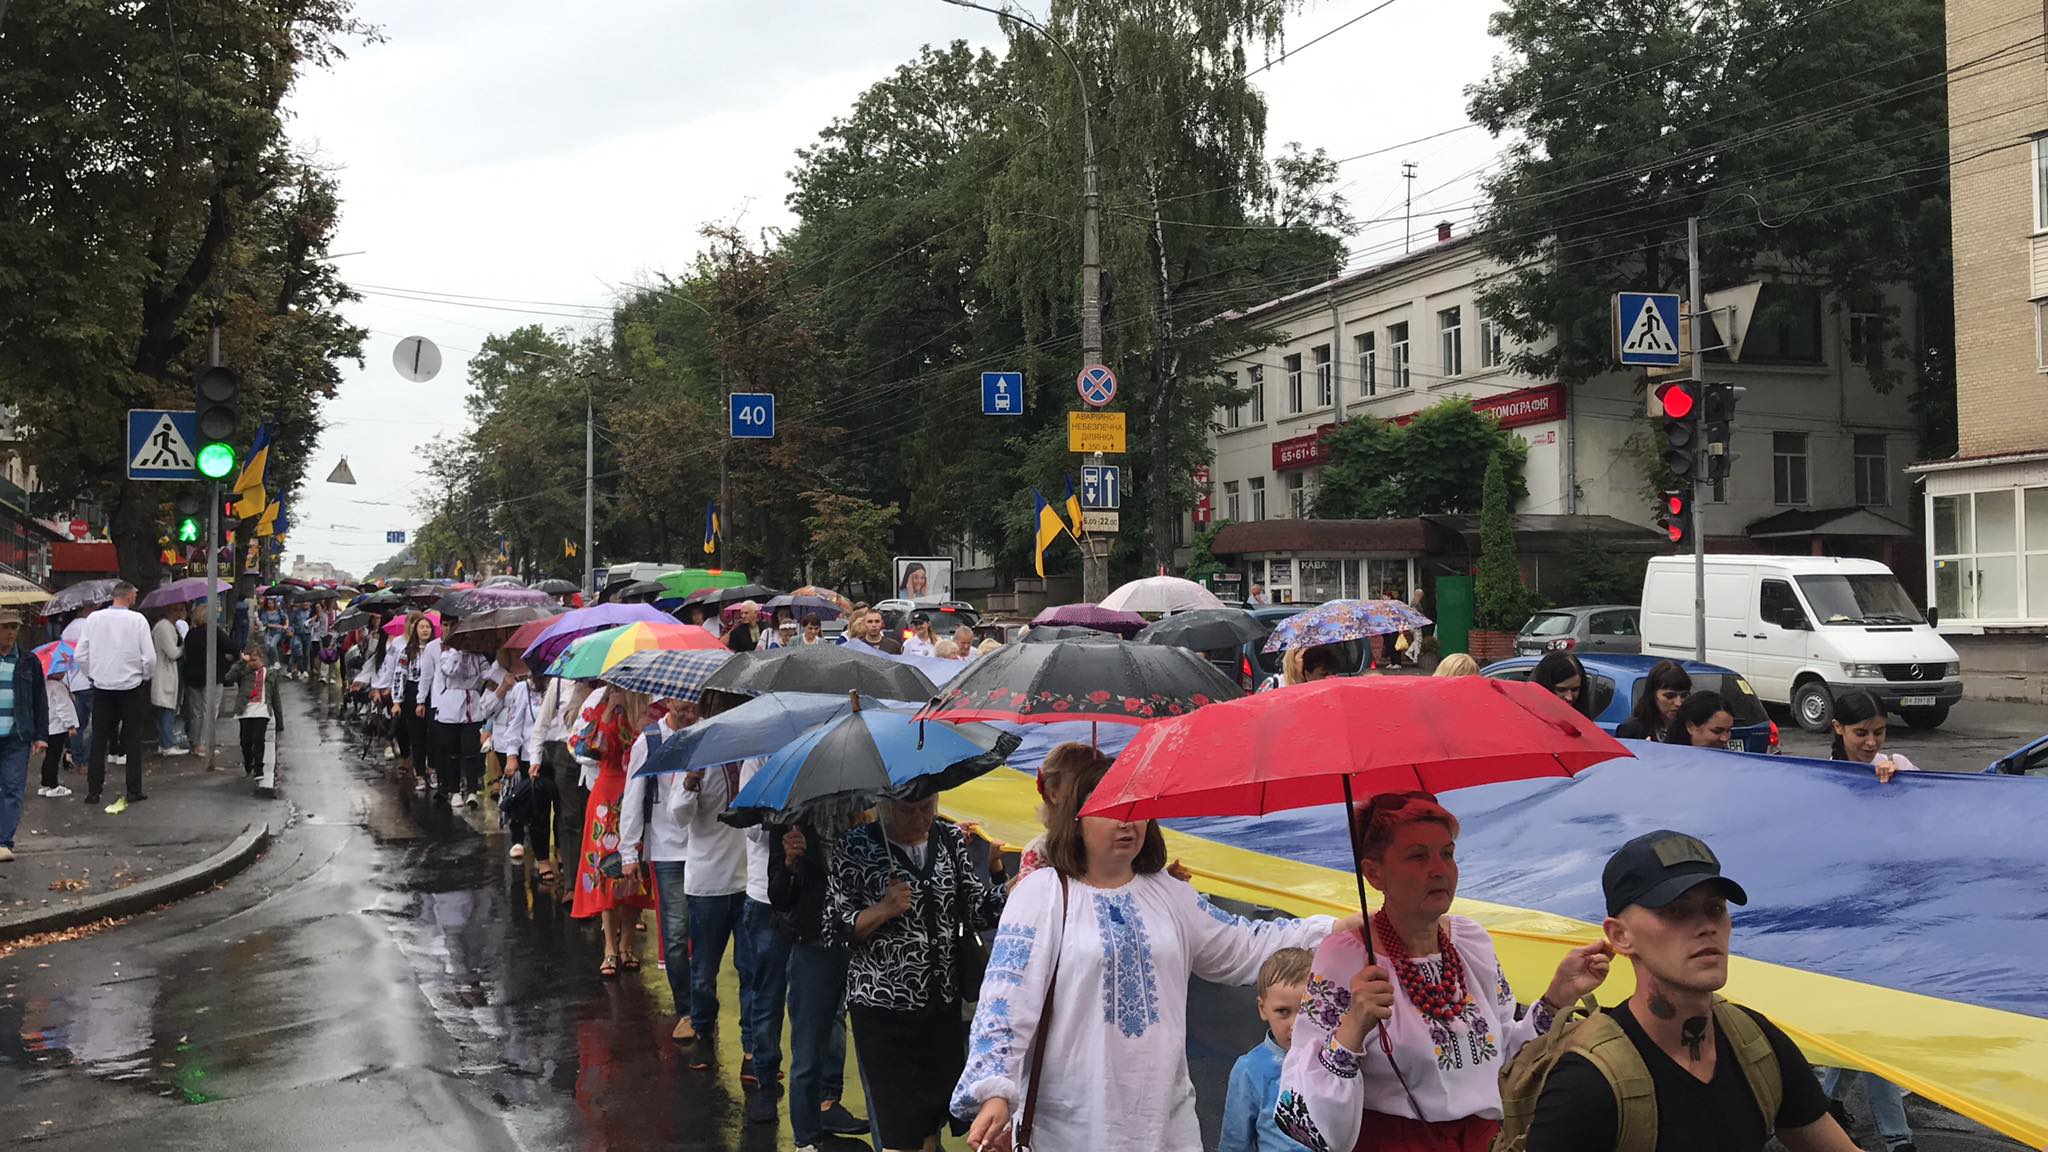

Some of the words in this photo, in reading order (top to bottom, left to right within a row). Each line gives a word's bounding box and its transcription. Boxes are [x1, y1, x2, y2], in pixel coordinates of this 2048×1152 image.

[739, 405, 766, 425] 40
[1072, 422, 1123, 431] НЕБЕЗПЕЧНА
[1081, 433, 1114, 441] ДІЛЯНКА
